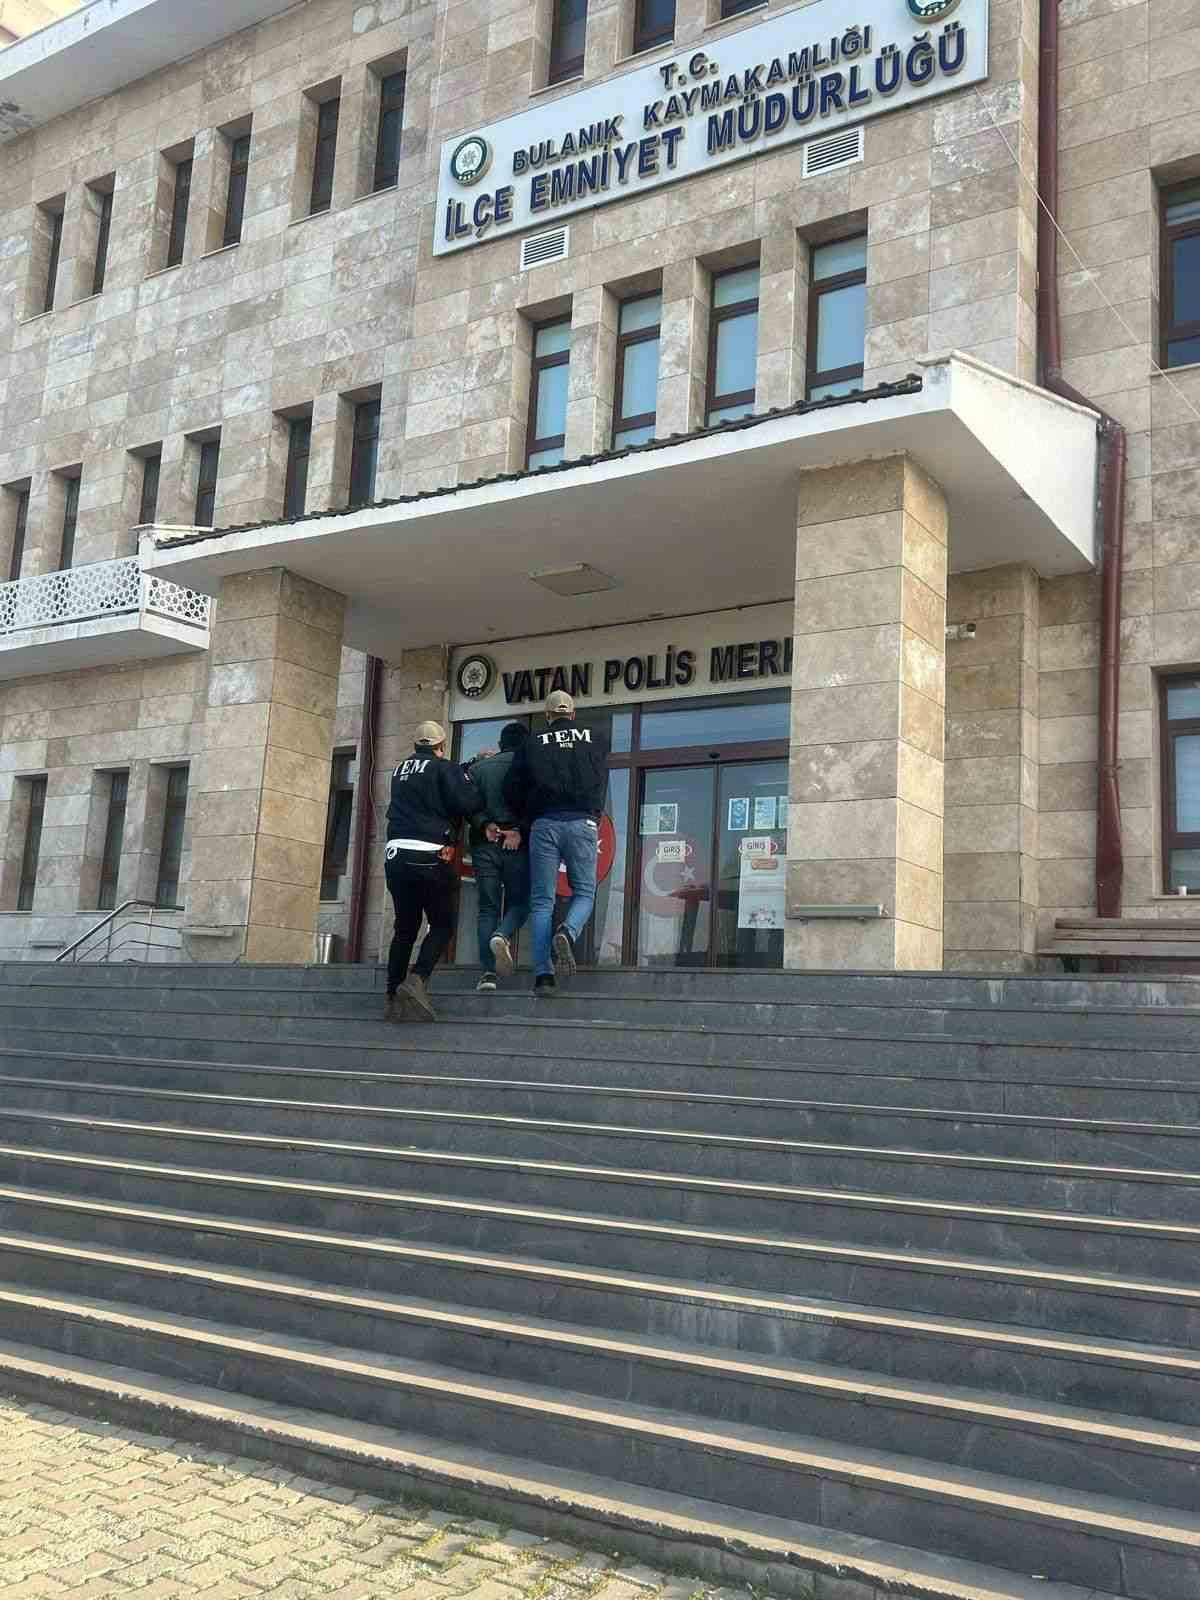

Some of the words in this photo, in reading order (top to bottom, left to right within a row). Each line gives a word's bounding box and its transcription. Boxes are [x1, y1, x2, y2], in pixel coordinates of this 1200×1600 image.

[660, 52, 718, 90] T.C.
[513, 114, 624, 176] BULANIK
[643, 24, 873, 129] KAYMAKAMLIĞI
[445, 185, 515, 241] İLÇE
[529, 126, 686, 213] EMNİYET
[706, 21, 967, 155] MÜDÜRLÜĞÜ
[502, 662, 593, 705] VATAN
[603, 644, 696, 695] POLİS
[536, 728, 593, 745] TEM
[391, 760, 431, 777] TEM
